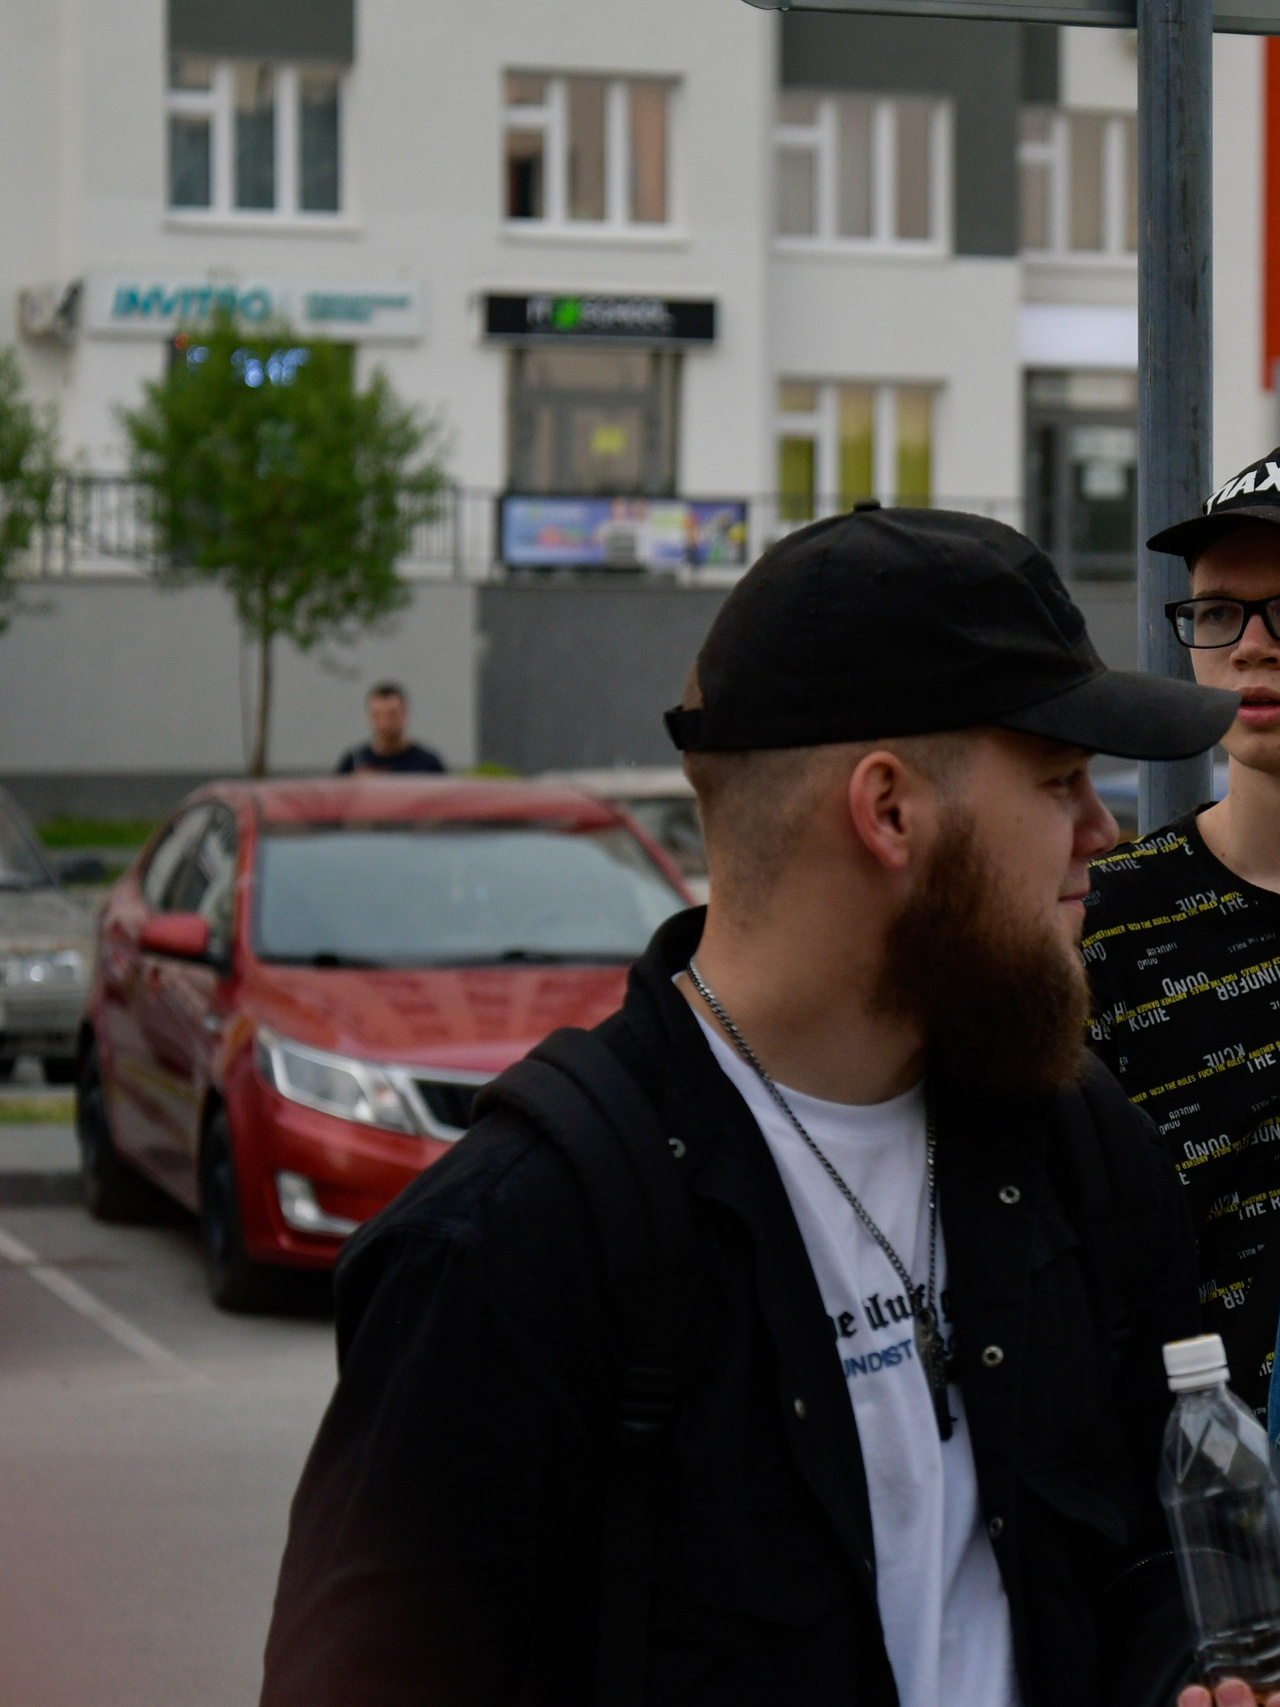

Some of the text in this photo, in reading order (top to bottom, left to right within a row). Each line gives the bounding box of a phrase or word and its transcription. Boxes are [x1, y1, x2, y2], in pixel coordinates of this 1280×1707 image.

[1165, 1081, 1177, 1091] THE
[1177, 1074, 1196, 1087] RULES
[1197, 1066, 1214, 1080] FUCK
[1226, 1053, 1246, 1068] RULES
[1248, 1043, 1275, 1060] ANOTHER
